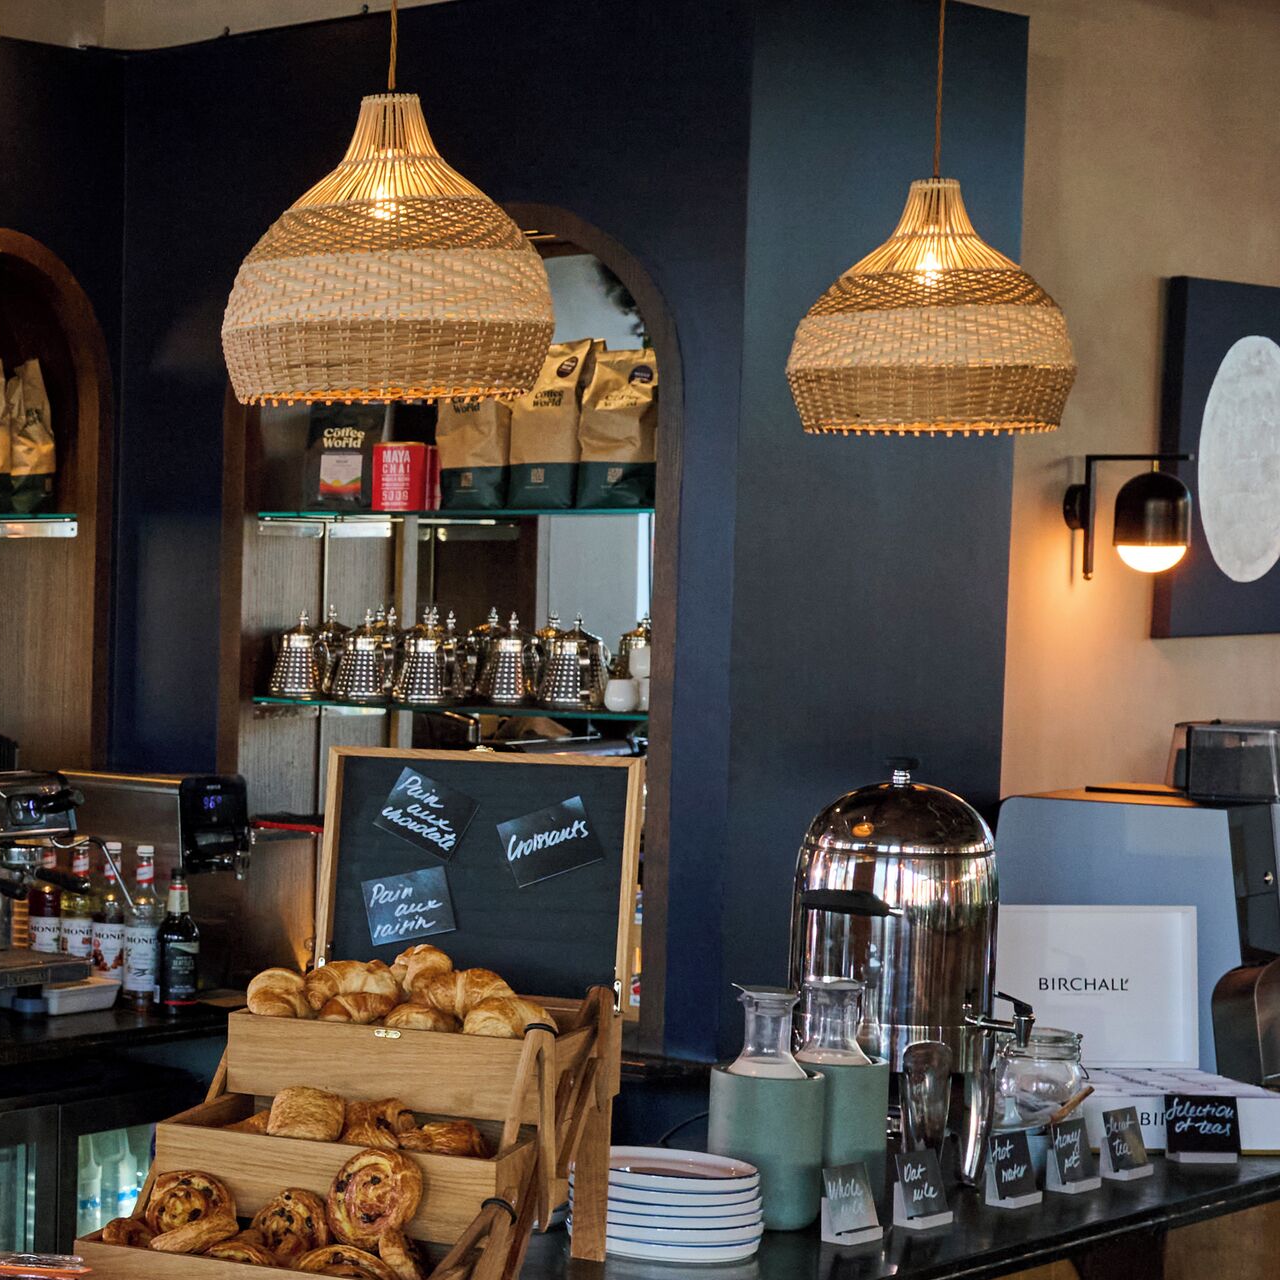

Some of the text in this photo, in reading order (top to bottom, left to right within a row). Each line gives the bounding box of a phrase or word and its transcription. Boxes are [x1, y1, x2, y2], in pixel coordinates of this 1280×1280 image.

[322, 437, 362, 449] World
[323, 427, 365, 439] Coffee
[382, 450, 411, 463] MAYA
[382, 463, 410, 474] CHAI
[396, 774, 444, 809] Pain
[406, 803, 453, 832] aux
[507, 819, 589, 862] Croissants
[370, 883, 413, 908] Pain
[395, 898, 443, 918] aux
[373, 914, 437, 940] raisin
[1038, 977, 1129, 992] BIRCHALL
[1165, 1096, 1235, 1121] Selection
[1175, 1118, 1231, 1137] of teas
[904, 1163, 926, 1183] Oat
[828, 1177, 864, 1201] Whole
